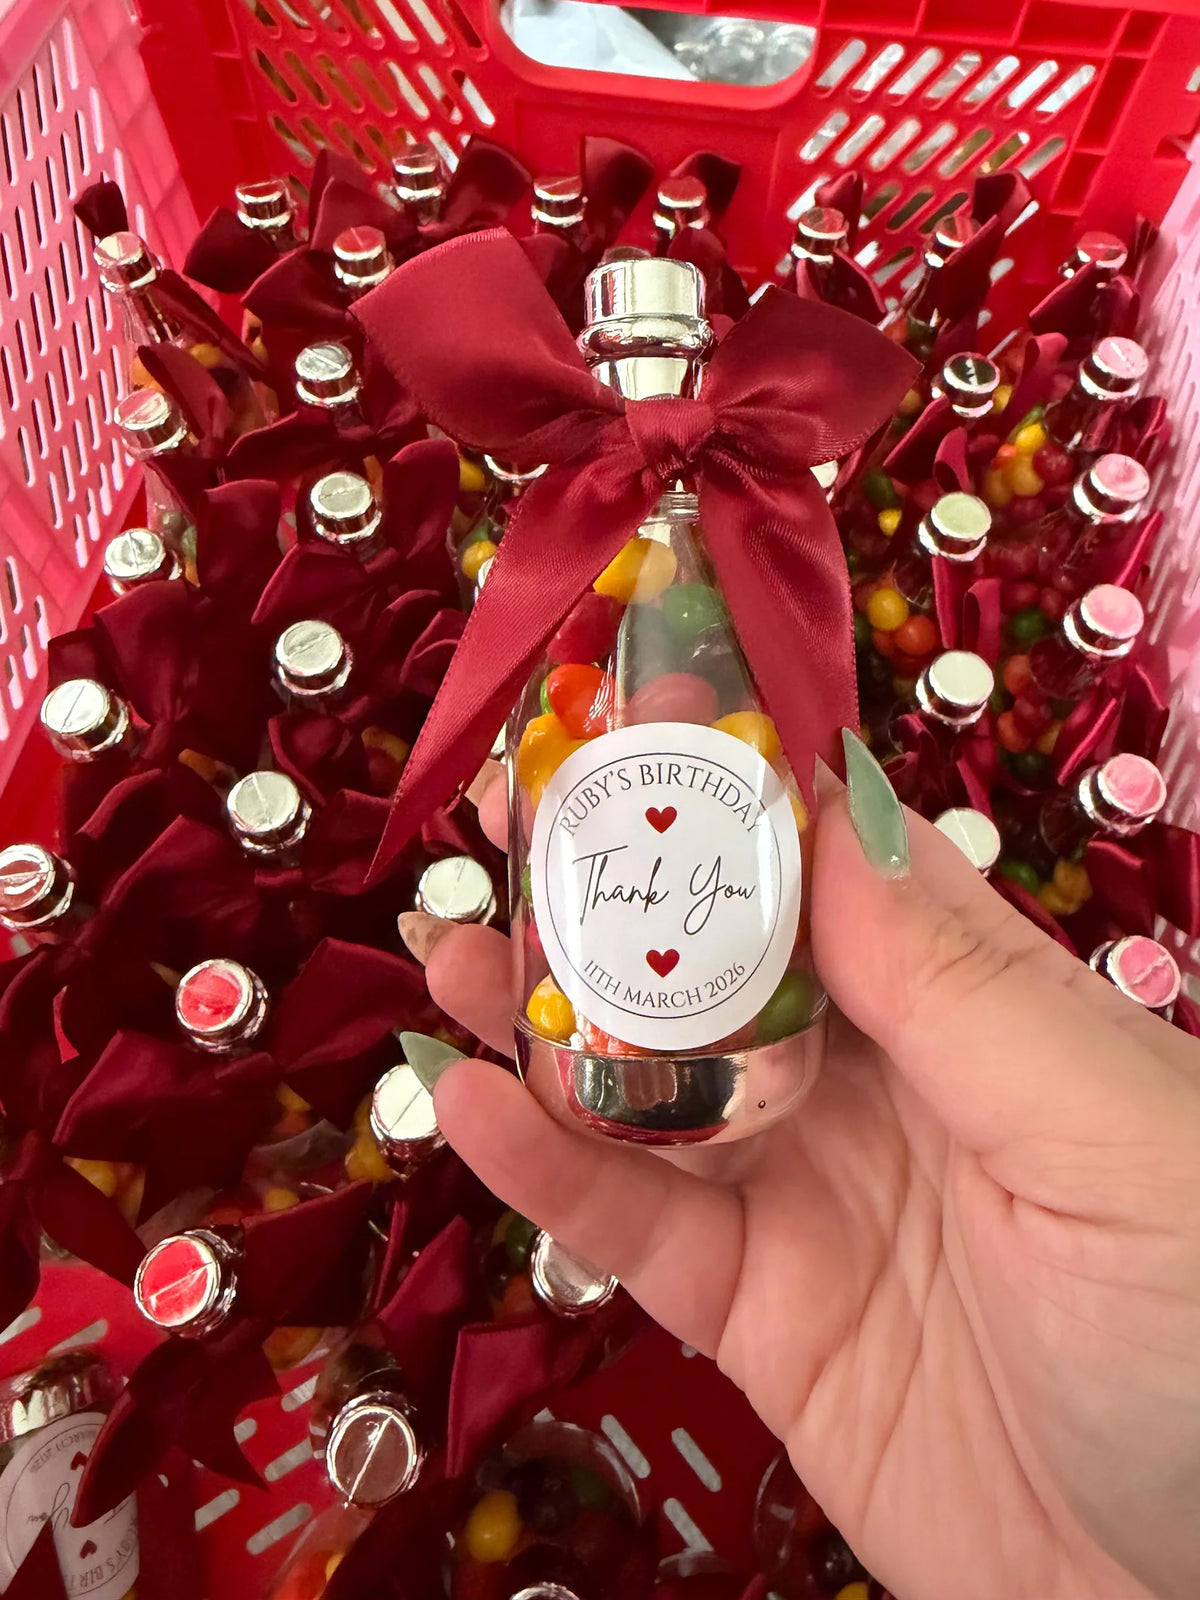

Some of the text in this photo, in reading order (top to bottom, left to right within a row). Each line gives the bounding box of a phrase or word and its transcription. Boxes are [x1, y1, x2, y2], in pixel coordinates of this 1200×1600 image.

[560, 763, 761, 837] RUBY'S BIRTHDAY
[572, 845, 756, 935] Thank You
[624, 986, 703, 1009] MARCH
[705, 962, 745, 998] 2026
